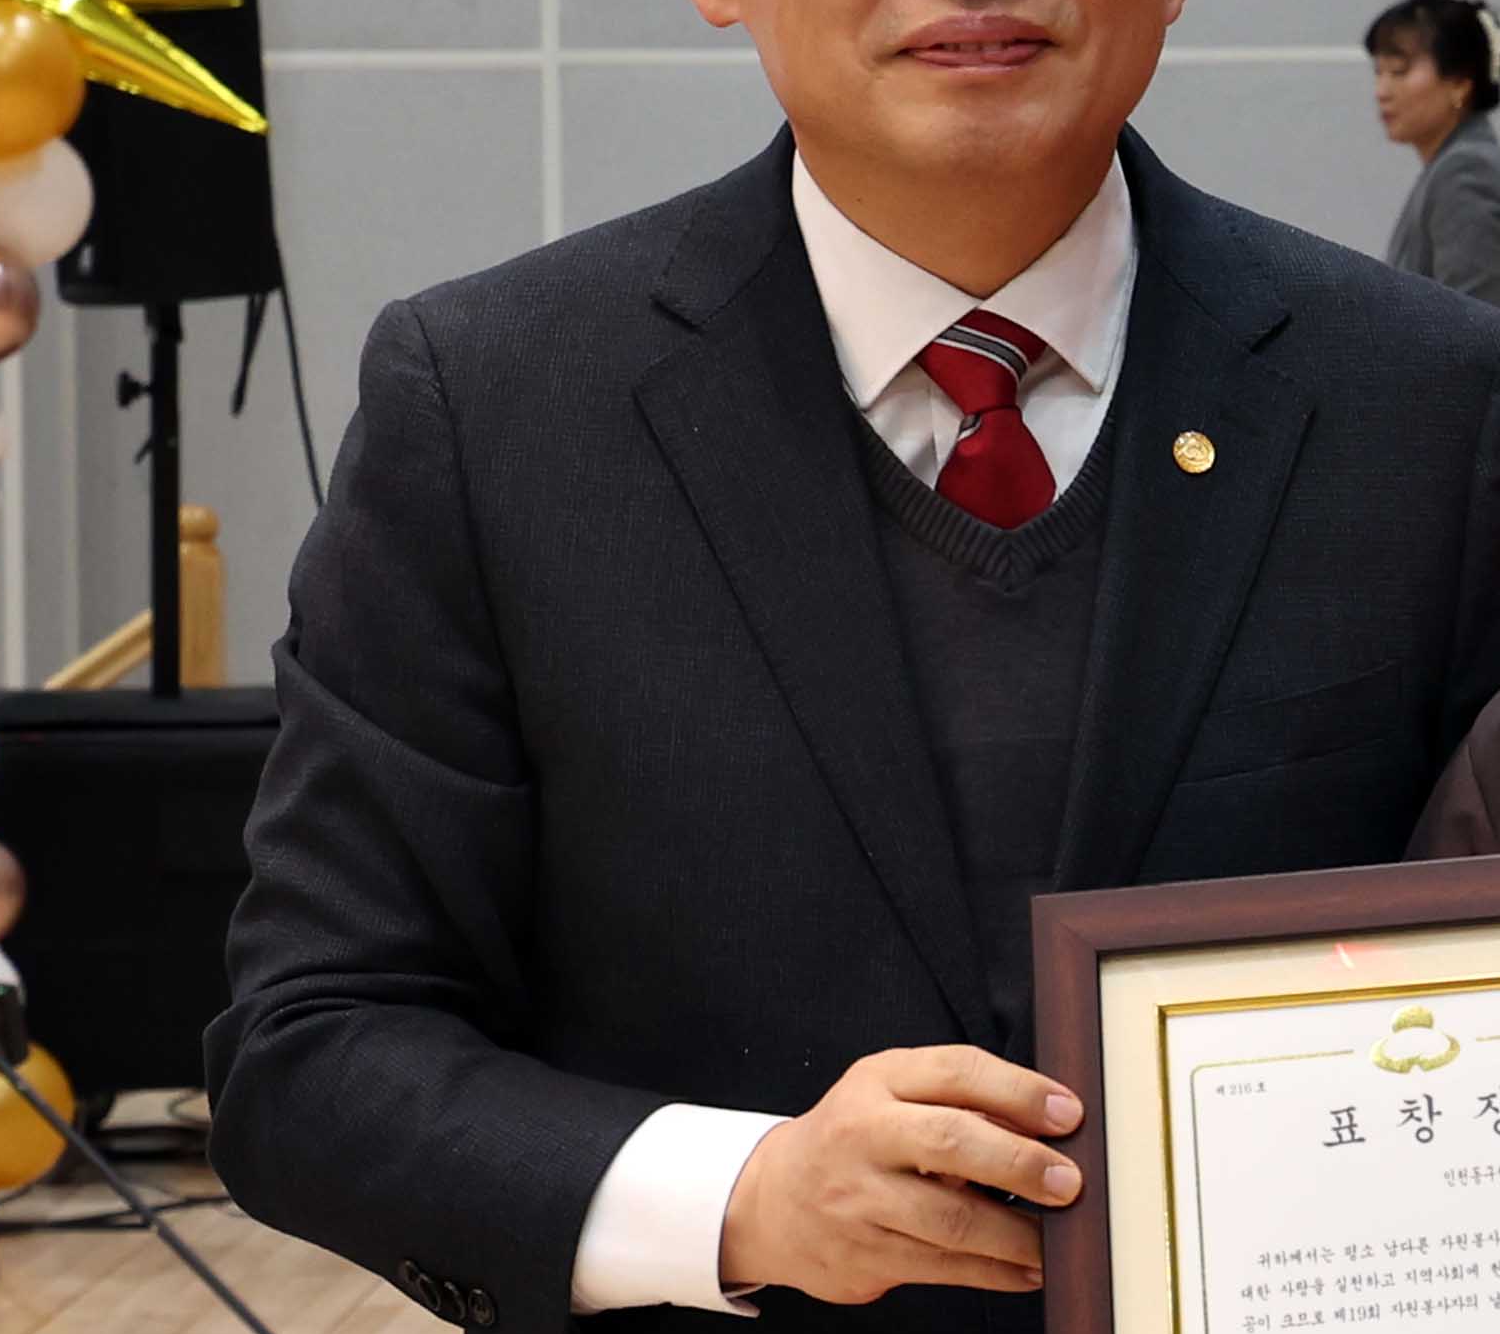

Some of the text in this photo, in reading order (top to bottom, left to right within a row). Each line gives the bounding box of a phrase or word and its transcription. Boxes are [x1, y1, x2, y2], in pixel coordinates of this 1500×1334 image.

[1344, 1243, 1375, 1262] 평소
[1383, 1236, 1429, 1259] 남다른
[1240, 1282, 1272, 1302] 대한
